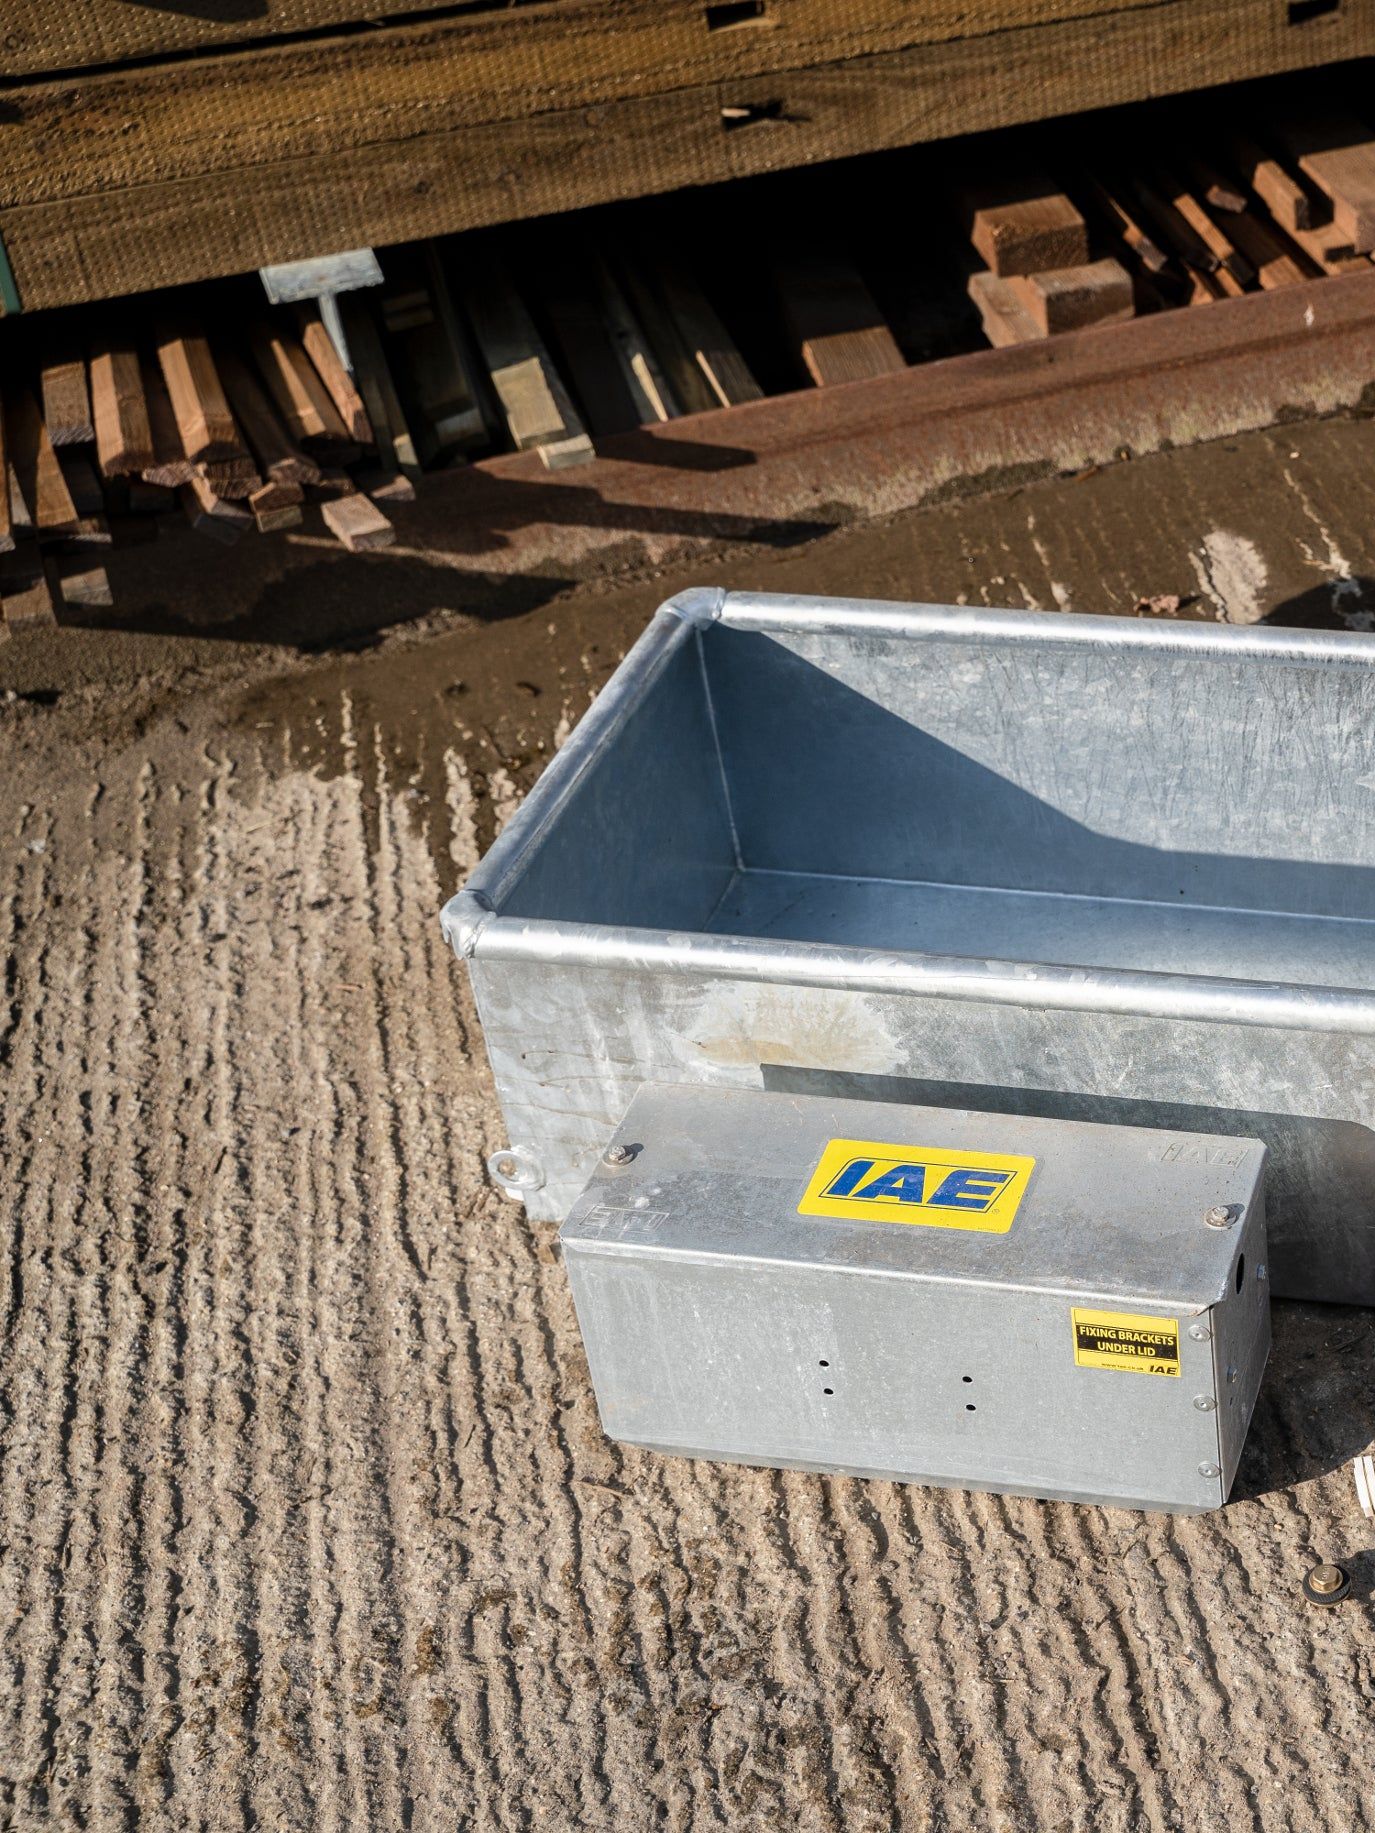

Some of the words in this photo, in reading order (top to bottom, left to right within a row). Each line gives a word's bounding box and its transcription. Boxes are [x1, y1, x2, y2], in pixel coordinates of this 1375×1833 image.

[827, 1160, 1009, 1210] IAE
[1080, 1326, 1116, 1339] FIXING
[1118, 1331, 1174, 1346] BRACKETS
[1097, 1341, 1136, 1355] UNDER
[1138, 1347, 1156, 1357] LID
[1149, 1365, 1177, 1375] IAE
